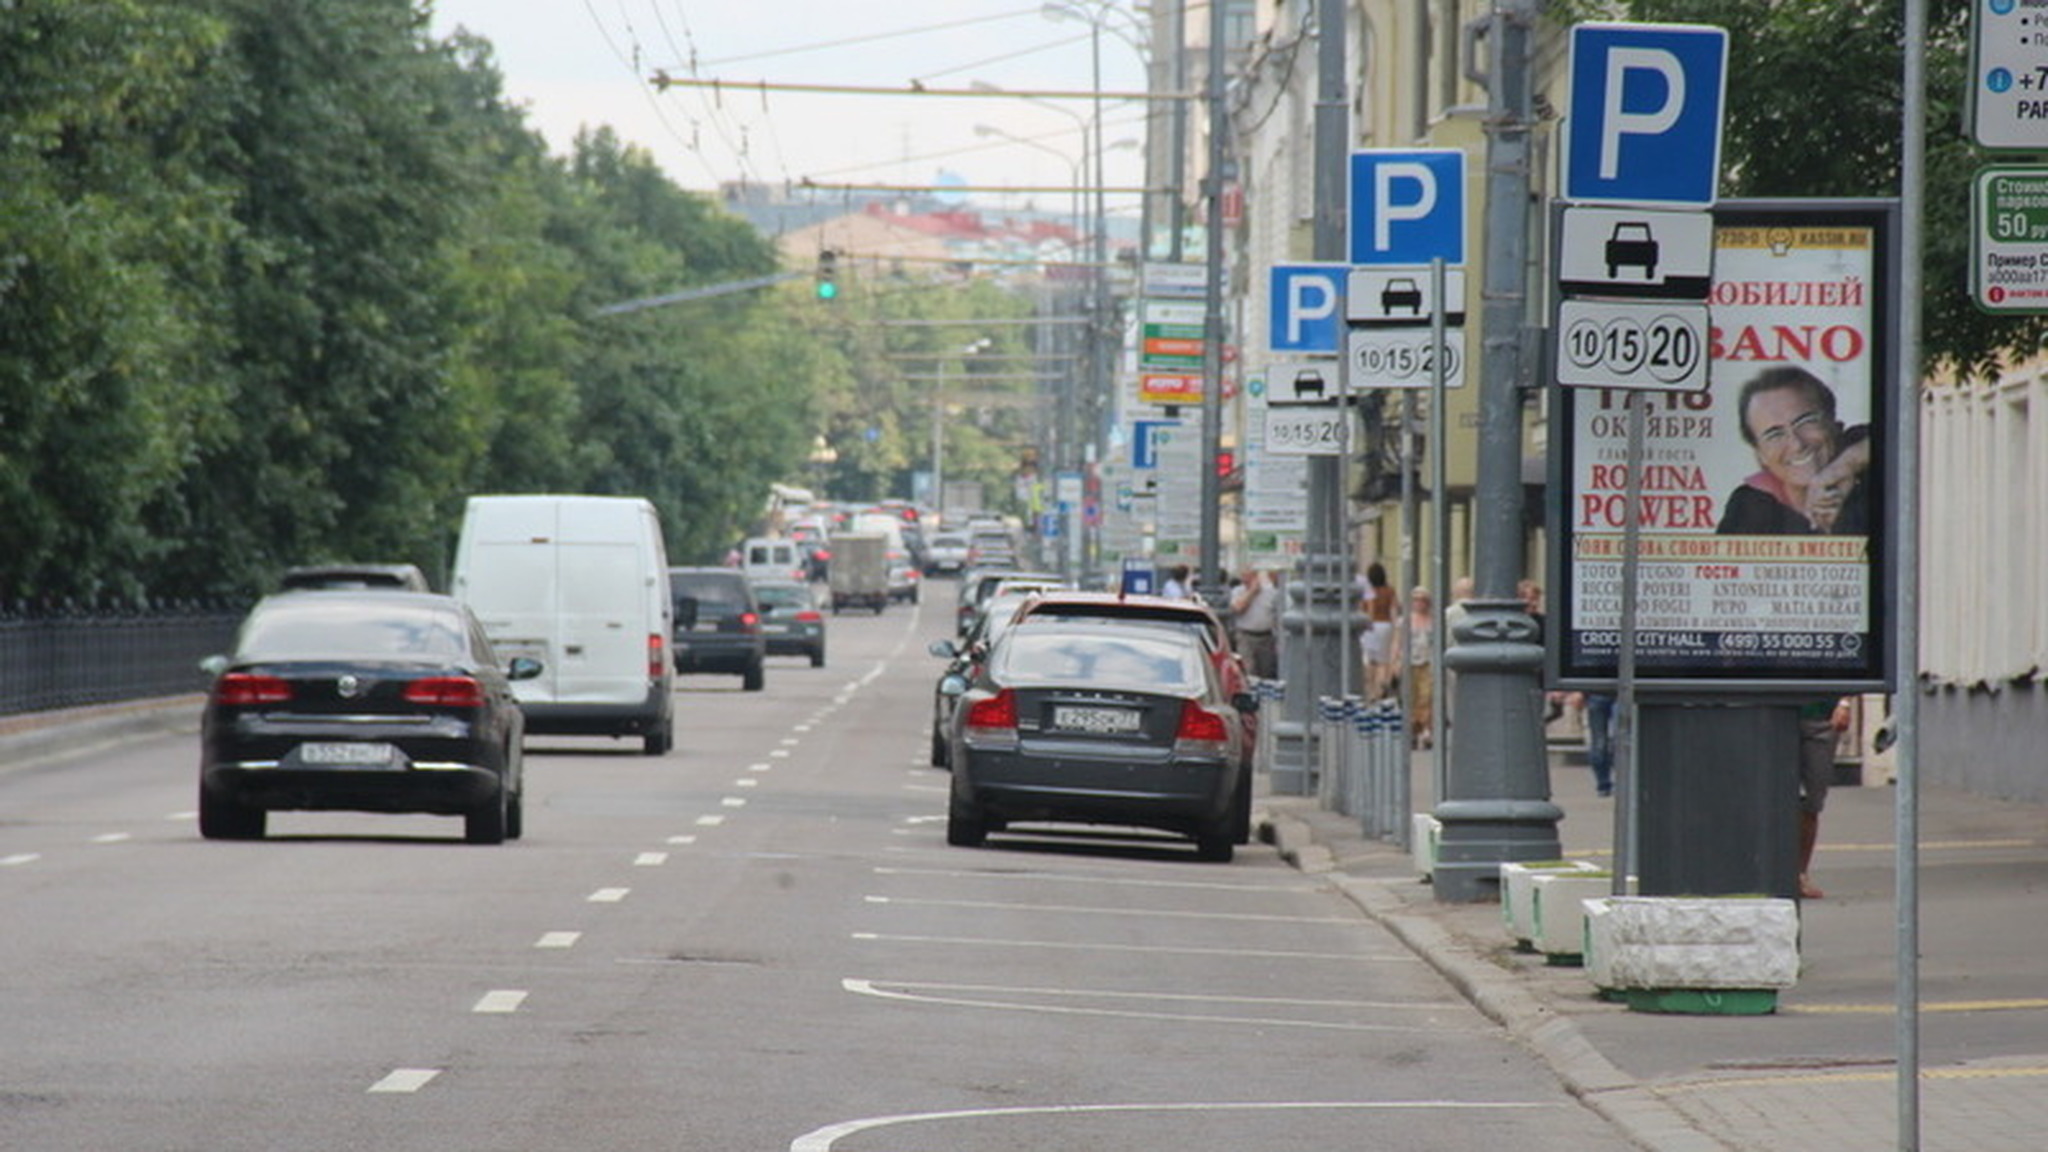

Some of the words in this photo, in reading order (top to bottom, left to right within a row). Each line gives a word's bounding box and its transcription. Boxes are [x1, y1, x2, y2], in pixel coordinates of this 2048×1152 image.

[1600, 46, 1685, 179] P
[1374, 162, 1437, 251] P
[1998, 213, 2027, 237] 50
[1287, 275, 1338, 343] P
[1360, 350, 1380, 368] 10
[1388, 348, 1412, 370] 15
[1571, 330, 1597, 357] 10
[1606, 328, 1639, 361] 15
[1651, 325, 1691, 367] 20
[1293, 424, 1313, 441] 15
[1591, 416, 1713, 438] ОКЯБРЯ
